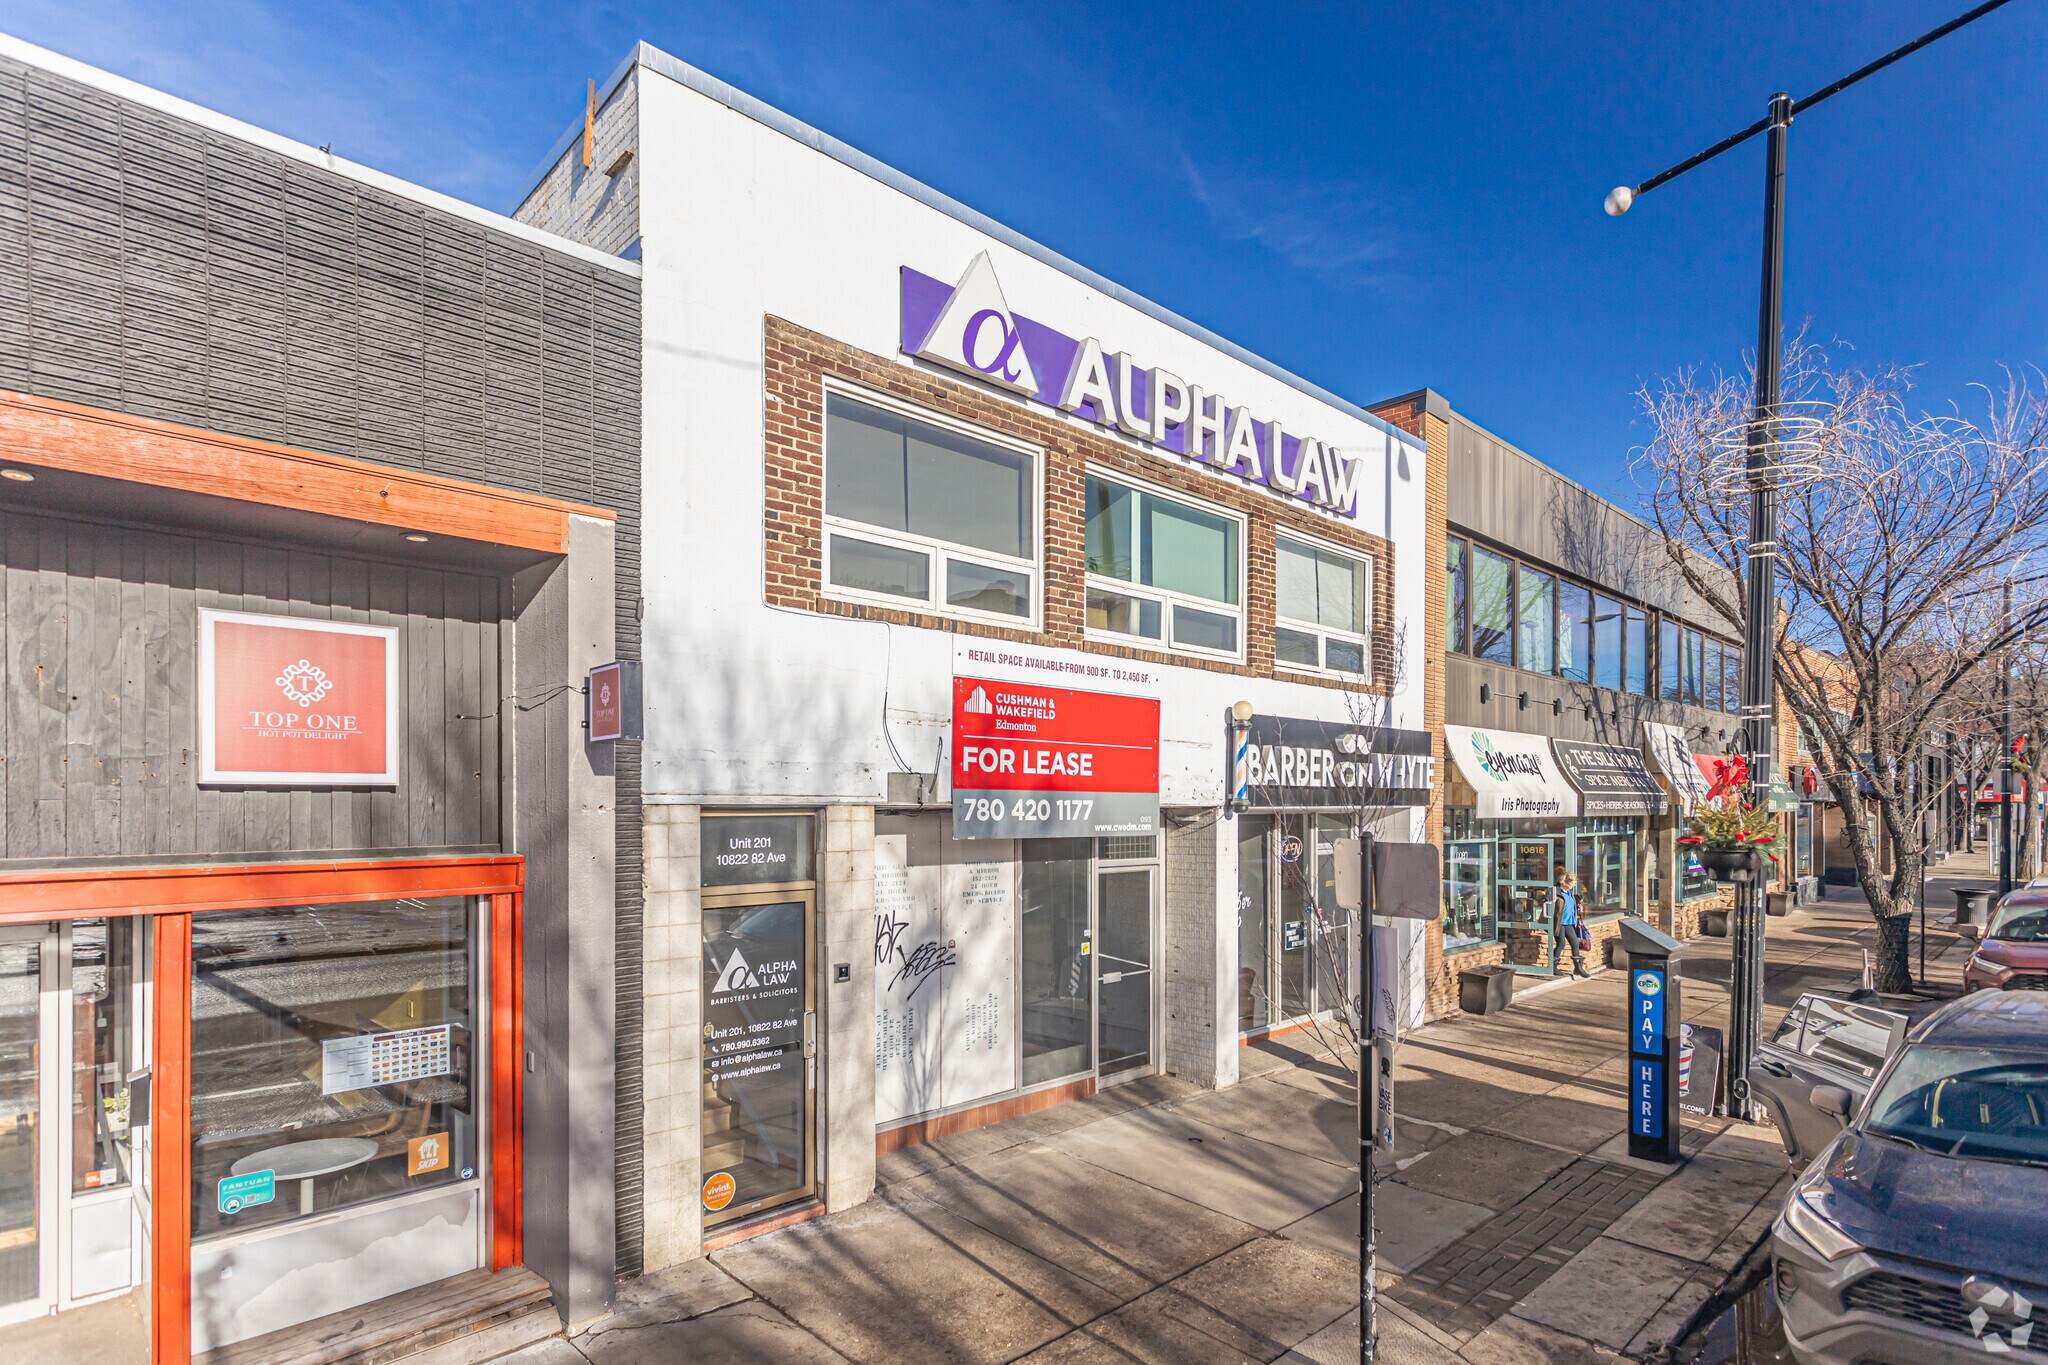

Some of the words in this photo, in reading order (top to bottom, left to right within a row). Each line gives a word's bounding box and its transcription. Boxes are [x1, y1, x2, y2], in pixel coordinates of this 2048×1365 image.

[1058, 337, 1263, 480] ALPHA
[1264, 420, 1365, 513] LAW
[968, 649, 996, 663] RETAIL
[998, 653, 1023, 667] SPACE
[1025, 657, 1063, 671] AVAILABLE
[1065, 664, 1085, 675] FROM
[1086, 667, 1099, 677] 900
[1100, 668, 1111, 678] SF.
[1113, 669, 1121, 679] TO
[1122, 671, 1140, 682] 2,450
[1141, 674, 1151, 683] SF.
[297, 676, 312, 691] T
[995, 693, 1047, 708] CUSHMAN
[1048, 698, 1055, 709] &
[995, 705, 1056, 720] WAKEFIELD
[249, 711, 299, 728] TOP
[306, 715, 357, 731] ONE
[995, 719, 1037, 732] Edmonton
[258, 730, 280, 738] HOT
[282, 731, 301, 739] POT
[304, 732, 348, 740] DELIGHT
[963, 746, 1016, 773] FOR
[1023, 750, 1093, 776] LEASE
[1246, 744, 1338, 787] BARBER
[1334, 762, 1373, 788] ON
[1570, 749, 1594, 765] THE
[1593, 751, 1618, 767] SILK
[1615, 753, 1641, 769] ROAD
[1584, 775, 1611, 786] SPICE
[963, 798, 1005, 822] 780
[1011, 799, 1050, 821] 420
[1056, 799, 1094, 821] 1177
[1502, 798, 1515, 811] Iris
[1516, 798, 1560, 814] Photography
[1586, 801, 1604, 809] SPICES
[1605, 801, 1622, 809] HERBS
[1094, 822, 1152, 832] www.cwedm.com
[729, 838, 751, 849] Unit
[753, 837, 771, 848] 201
[1520, 846, 1545, 854] 10818
[716, 854, 749, 866] 10822
[751, 853, 764, 864] 82
[766, 852, 786, 863] Ave
[758, 960, 797, 975] ALPHA
[763, 973, 789, 986] LAW
[710, 994, 750, 1006] BARRISTERS
[759, 987, 798, 999] SOLICITORS
[711, 1028, 728, 1039] Unit
[729, 1026, 746, 1036] 201,
[748, 1022, 771, 1033] 10822
[772, 1020, 782, 1029] 82
[783, 1019, 798, 1028] Ave
[1642, 1000, 1653, 1049] PAY
[720, 1037, 770, 1052] 780.990.6362
[720, 1048, 783, 1066] info@alphalaw.ca
[720, 1062, 781, 1080] www.alphalaw.ca
[1641, 1066, 1653, 1133] HERE
[1679, 1103, 1706, 1115] ELCOME
[416, 1158, 438, 1170] SKIP
[223, 1176, 271, 1190] FANTUAN
